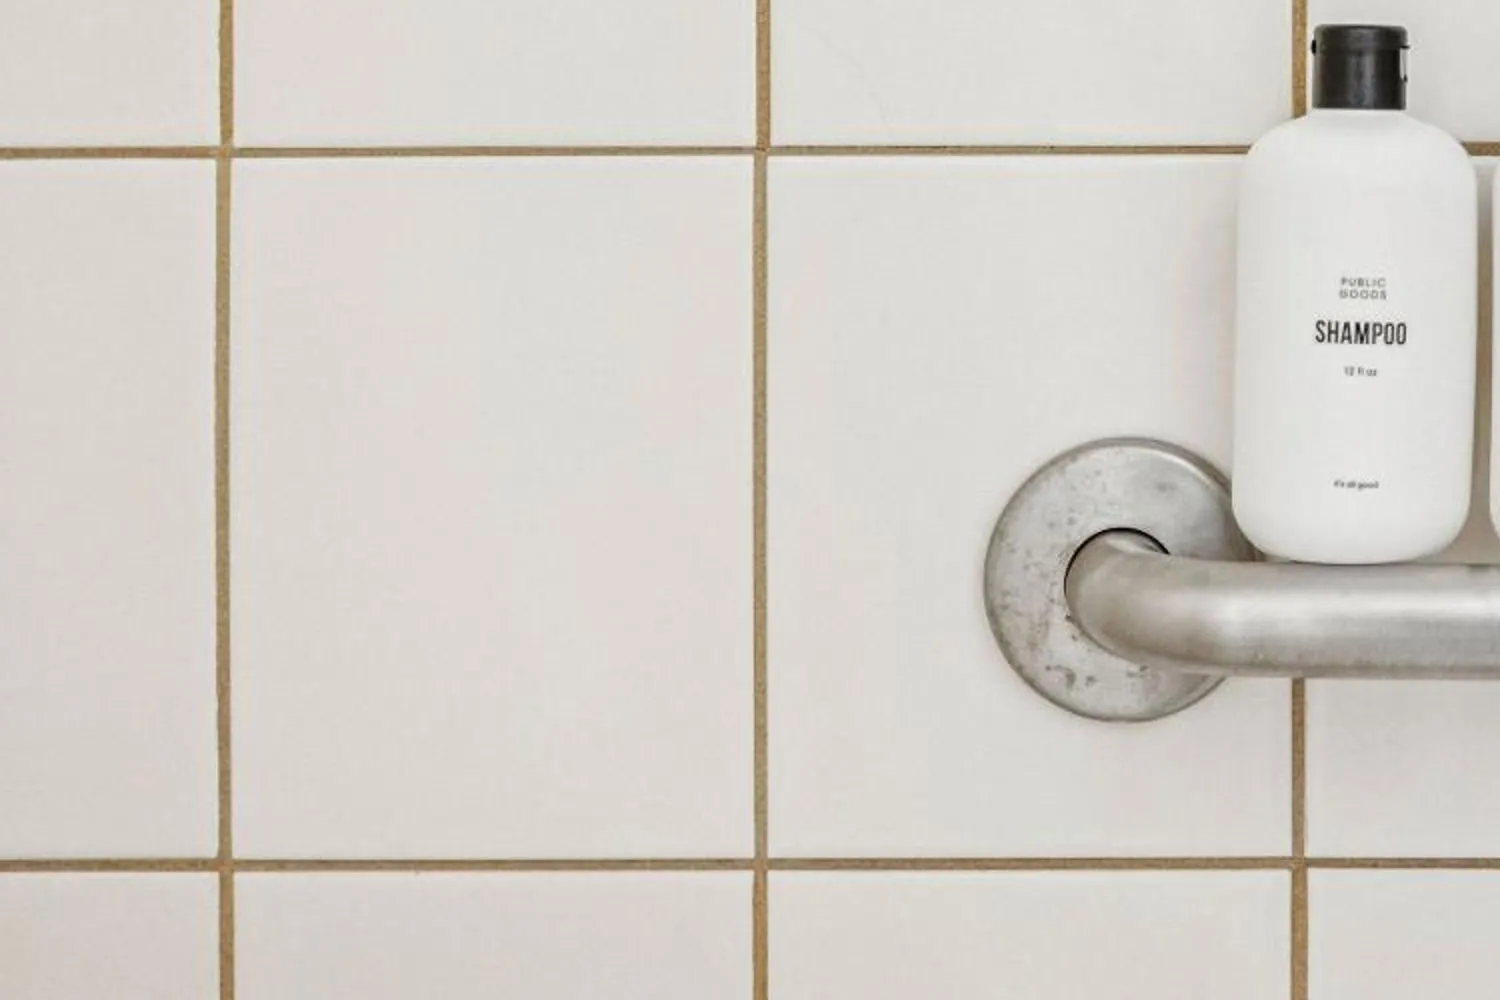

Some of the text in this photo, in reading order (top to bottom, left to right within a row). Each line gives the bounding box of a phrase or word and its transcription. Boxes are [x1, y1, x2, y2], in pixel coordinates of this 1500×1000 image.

[1339, 277, 1387, 288] PUBLIC
[1338, 289, 1388, 300] GOODS
[1314, 319, 1408, 346] SHAMPOO
